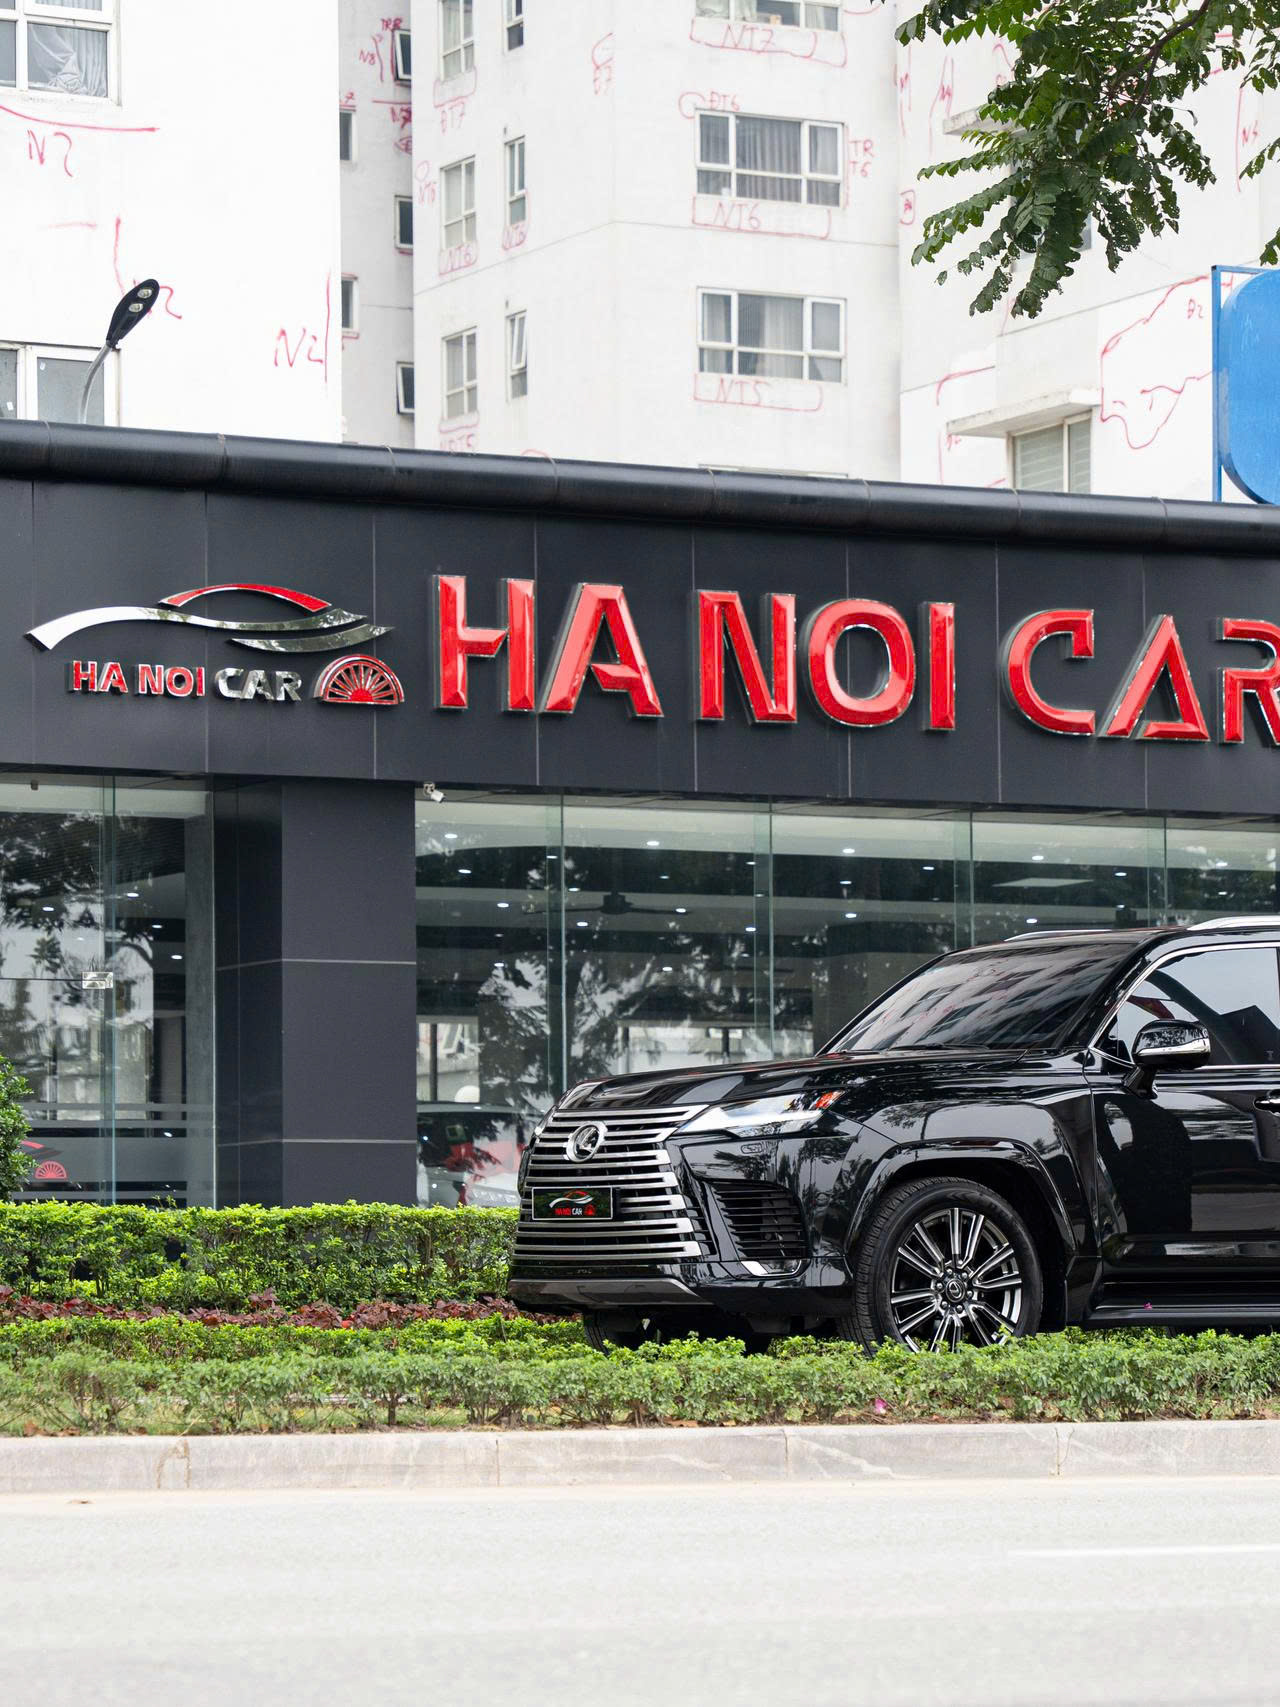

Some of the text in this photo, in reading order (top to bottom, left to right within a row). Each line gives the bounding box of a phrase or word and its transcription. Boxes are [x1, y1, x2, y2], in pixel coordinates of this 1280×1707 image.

[70, 660, 302, 702] HA NOI CAR
[432, 574, 664, 719] HA
[694, 588, 957, 732] NOI
